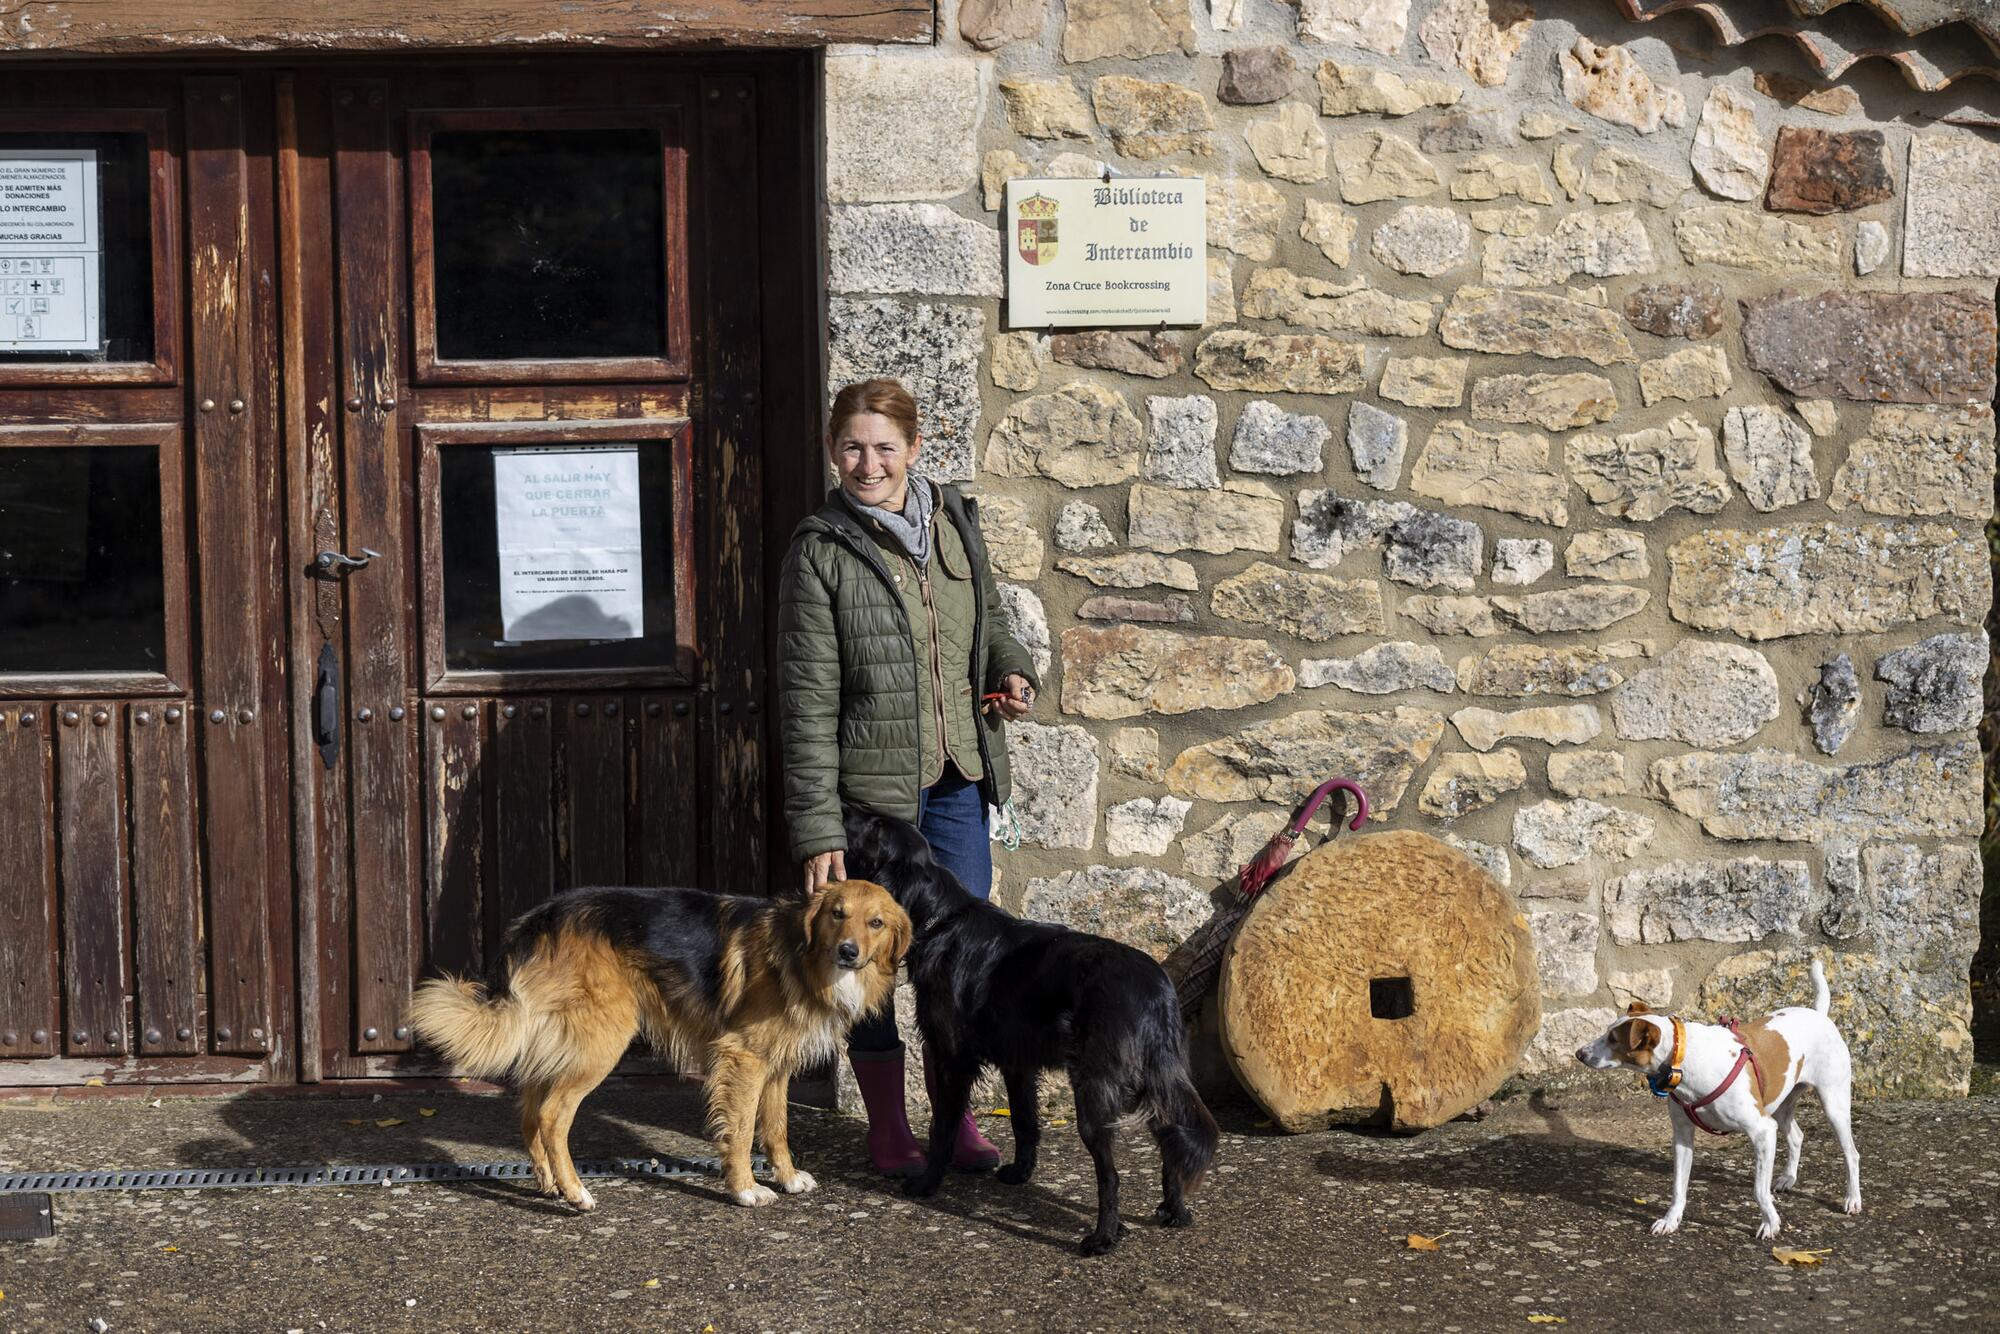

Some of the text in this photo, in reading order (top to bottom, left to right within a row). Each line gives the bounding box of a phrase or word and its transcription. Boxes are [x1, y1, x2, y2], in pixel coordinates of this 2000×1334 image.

[1093, 187, 1183, 207] Biblioteca
[1129, 217, 1149, 232] de
[1085, 243, 1193, 261] Intercambio
[1045, 280, 1171, 292] Zona Cruce Bookcrossing
[524, 472, 611, 484] AL SALIR HAY
[525, 488, 611, 501] QUE CERRAR
[531, 505, 606, 518] LA PUERTA
